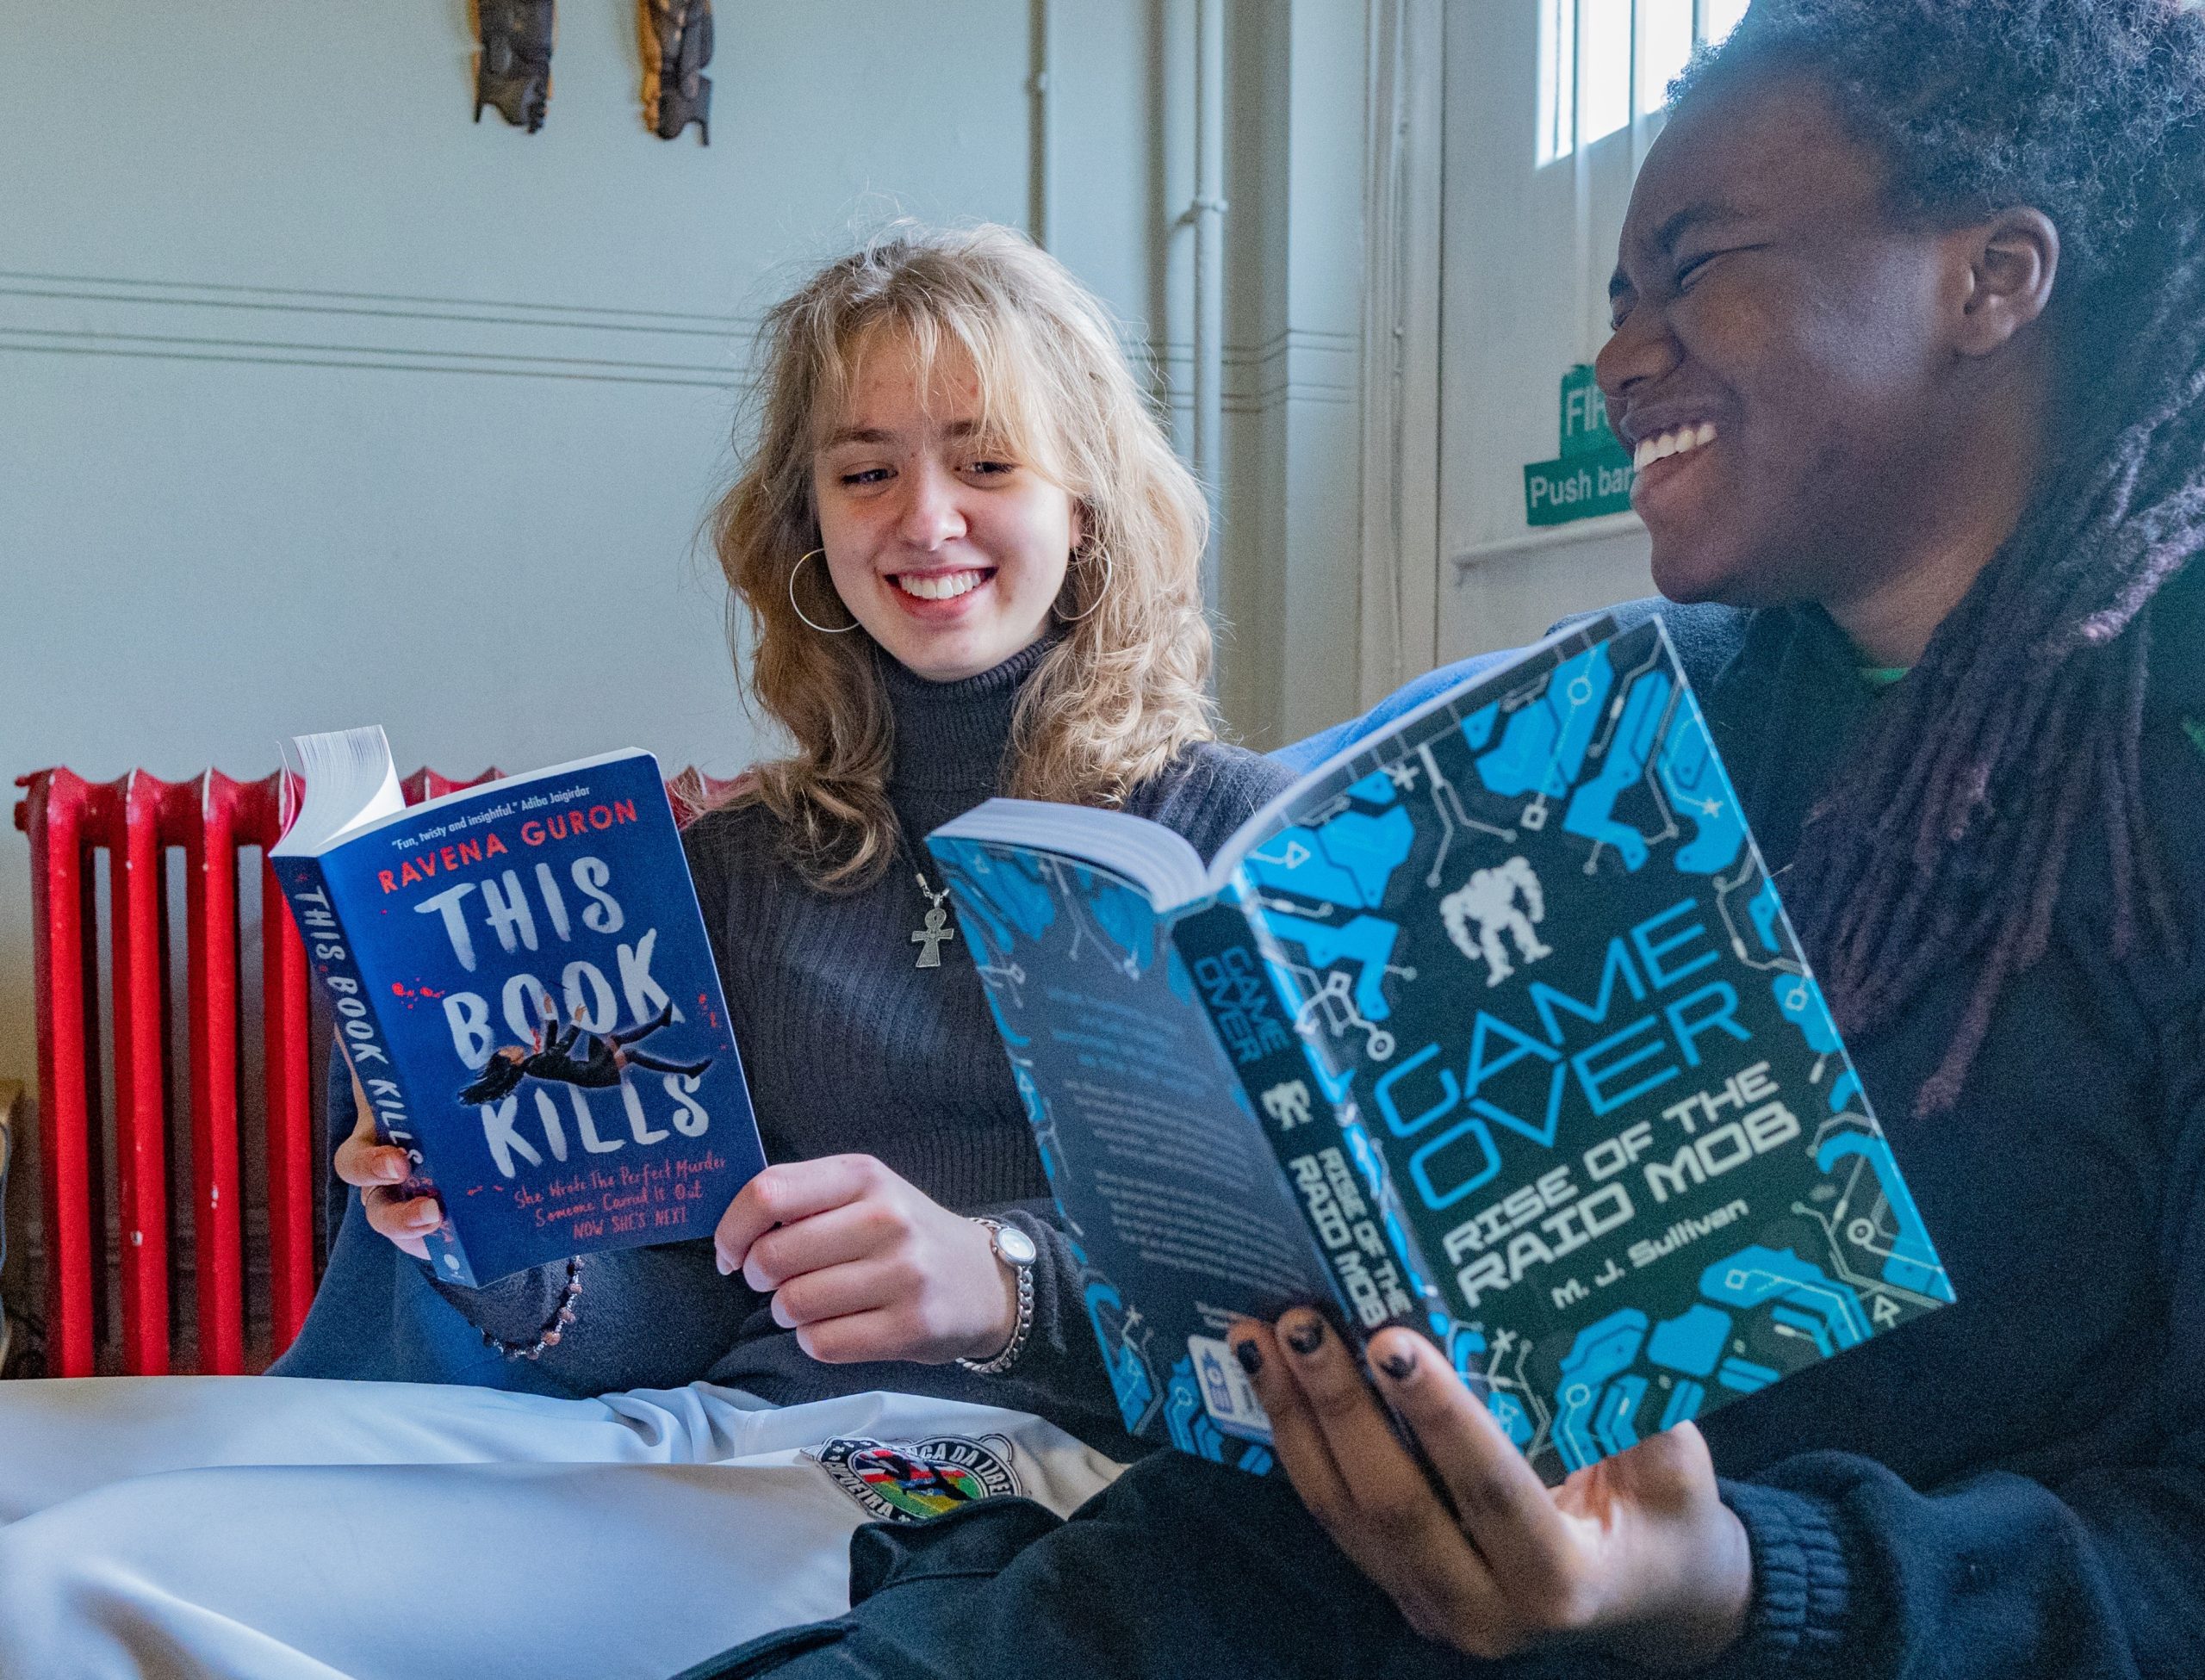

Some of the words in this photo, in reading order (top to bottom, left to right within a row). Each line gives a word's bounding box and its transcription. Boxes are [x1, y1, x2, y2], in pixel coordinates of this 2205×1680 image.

[1530, 468, 1592, 508] Push
[1598, 465, 1633, 498] bar
[377, 833, 508, 895] RAVENA
[521, 799, 638, 846] GURON
[419, 824, 446, 844] twisty
[449, 816, 468, 832] and
[521, 795, 548, 811] Adiba
[550, 785, 590, 804] Jaigirdar
[413, 856, 624, 972] THIS
[294, 885, 345, 960] THIS
[326, 976, 389, 1064] BOOK
[442, 927, 686, 1070] BOOK
[1193, 956, 1263, 1065] OVER
[1222, 945, 1291, 1054] GAME
[1374, 897, 1722, 1138] GAME
[481, 1074, 710, 1179] KILLS
[1409, 979, 1753, 1212] OVER
[514, 1185, 544, 1209] She
[549, 1173, 587, 1198] Wrote
[590, 1170, 615, 1190] The
[619, 1156, 671, 1187] Perfect
[676, 1150, 725, 1179] Murder
[535, 1201, 595, 1228] Someone
[674, 1179, 704, 1200] Out
[1442, 1165, 1579, 1267] RISE
[1582, 1120, 1654, 1182] OF
[1662, 1061, 1780, 1135] THE
[1456, 1183, 1636, 1308] RAID
[1643, 1100, 1803, 1203] MOB
[573, 1218, 605, 1240] NOW
[612, 1212, 646, 1234] SHE'S
[655, 1206, 687, 1227] NEXT
[1289, 1154, 1353, 1249] RAID
[1335, 1250, 1389, 1329] MOB
[1318, 1146, 1368, 1221] RISE
[1352, 1219, 1387, 1259] OF
[1374, 1258, 1413, 1317] THE
[1551, 1273, 1590, 1310] M.
[1595, 1259, 1625, 1289] J.
[1627, 1198, 1750, 1268] Sullivan
[949, 1445, 979, 1466] DA
